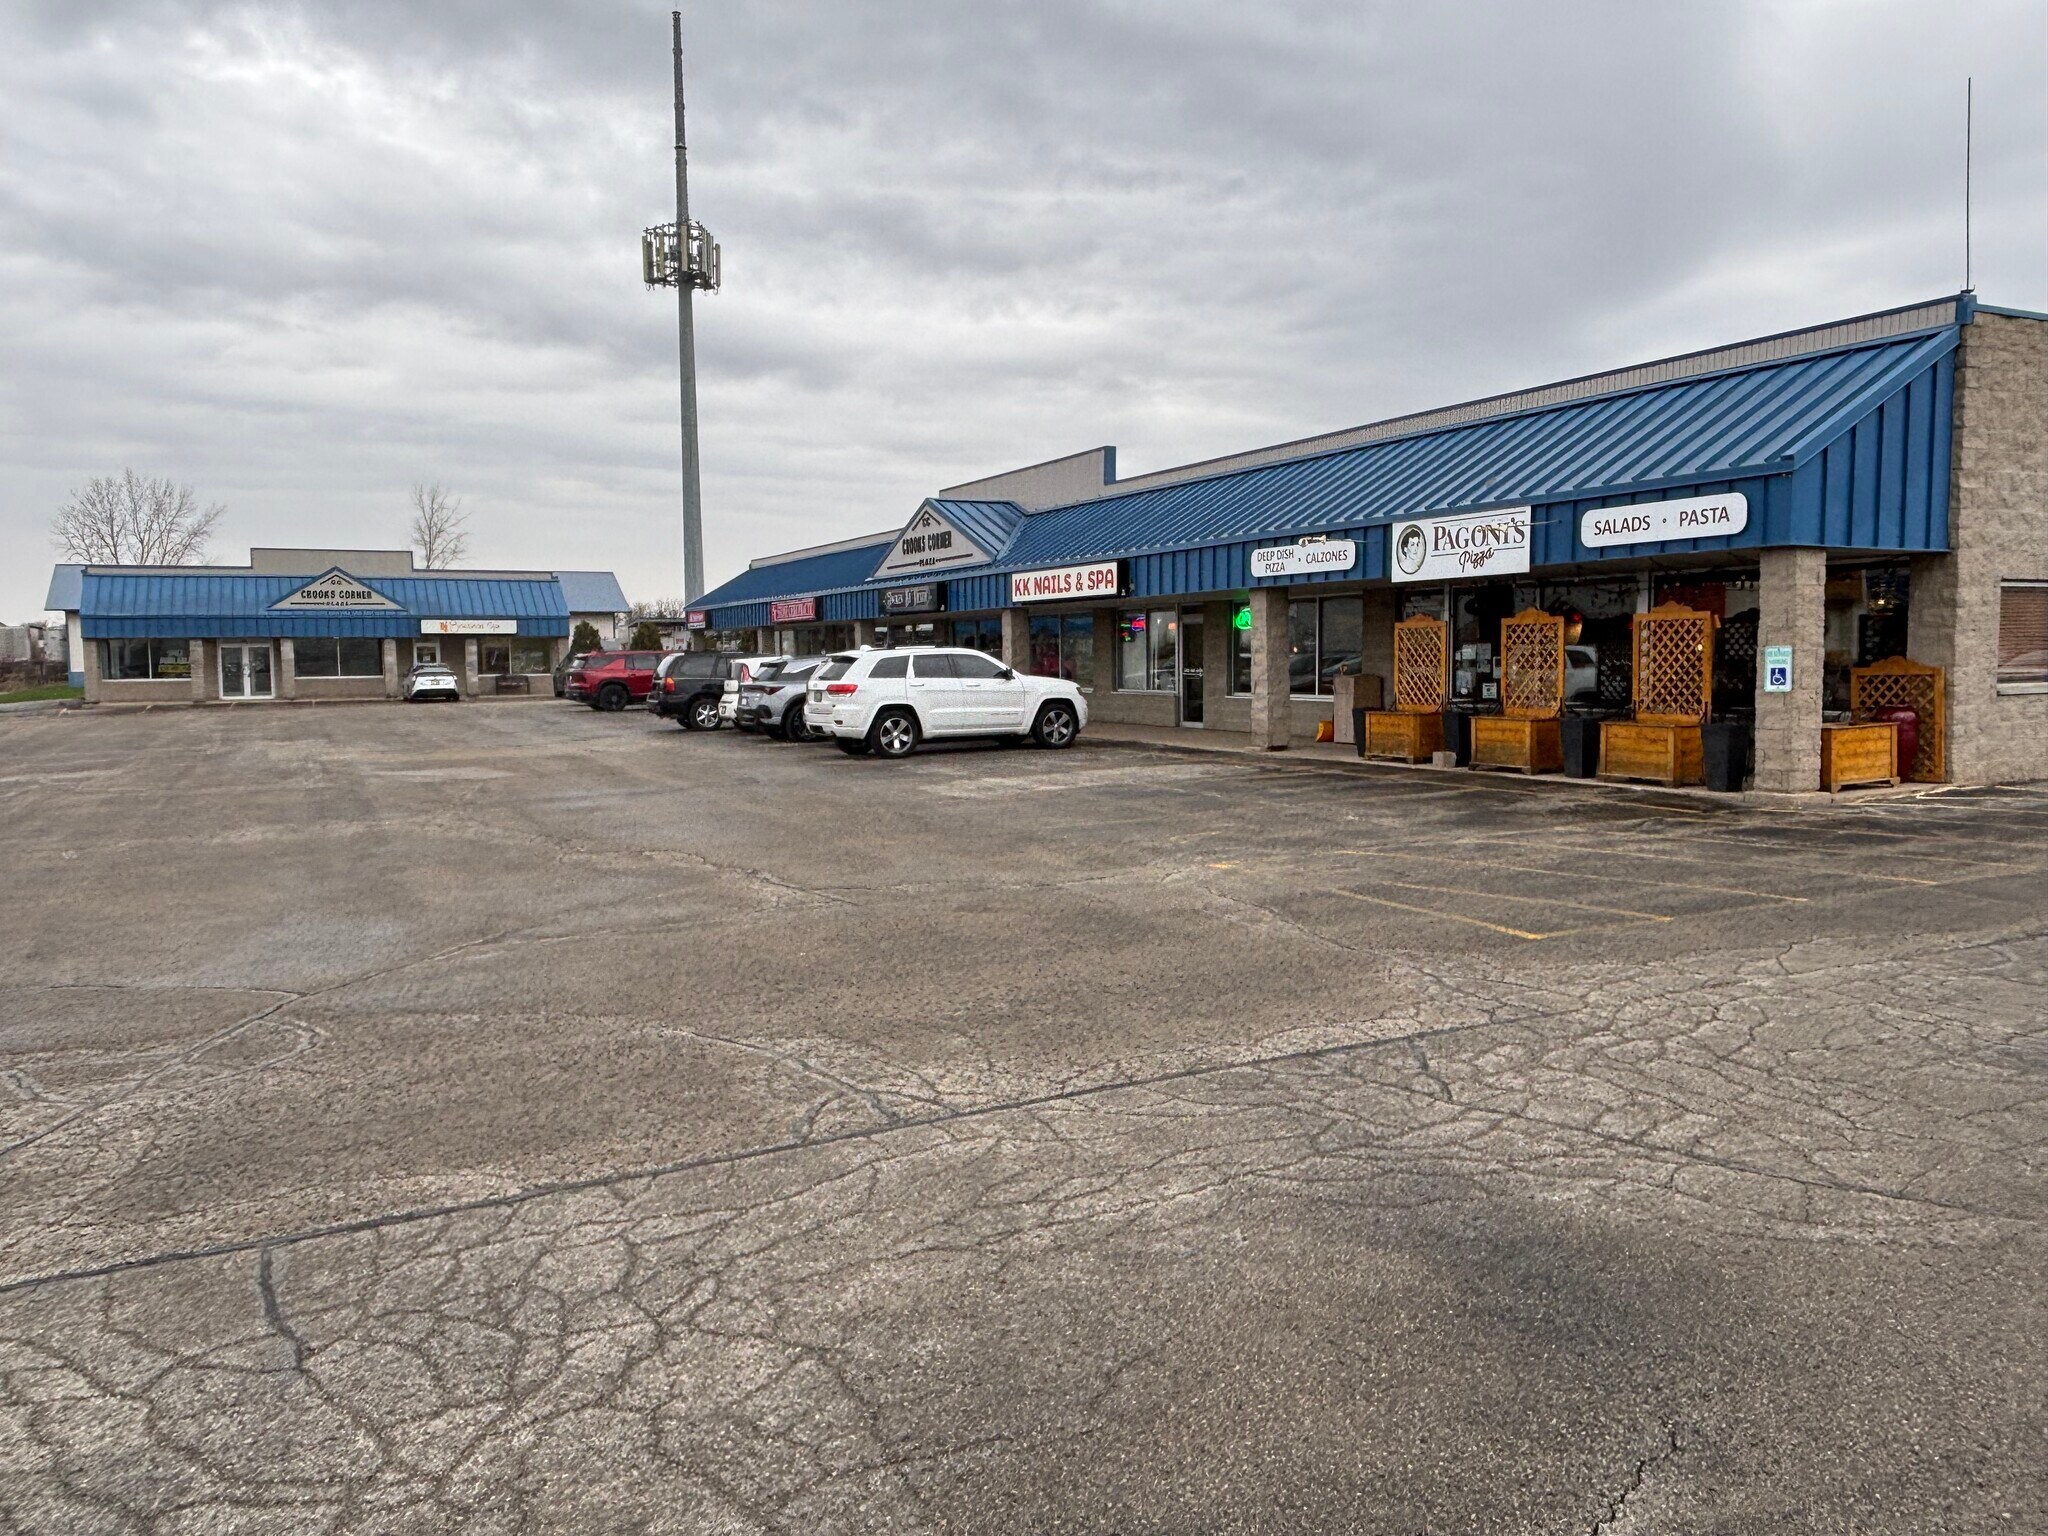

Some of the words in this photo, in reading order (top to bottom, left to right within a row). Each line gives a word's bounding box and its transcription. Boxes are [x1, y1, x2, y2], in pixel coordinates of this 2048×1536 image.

[1594, 515, 1651, 536] SALADS
[1679, 506, 1730, 527] PASTA
[902, 535, 926, 555] CROOKS
[927, 531, 952, 551] CORNER
[1432, 517, 1525, 551] PAGONI'S
[1257, 551, 1275, 562] DEEP
[1276, 548, 1294, 560] DISH
[1305, 549, 1348, 564] CALZONES
[1265, 562, 1286, 573] PIZZA
[1458, 547, 1495, 573] Pizza
[300, 590, 335, 599] CROOKS
[338, 590, 373, 599] CORNER
[1014, 577, 1031, 597] KK
[1033, 573, 1072, 596] NAILS
[1075, 572, 1084, 592] &
[1087, 568, 1114, 591] SPA
